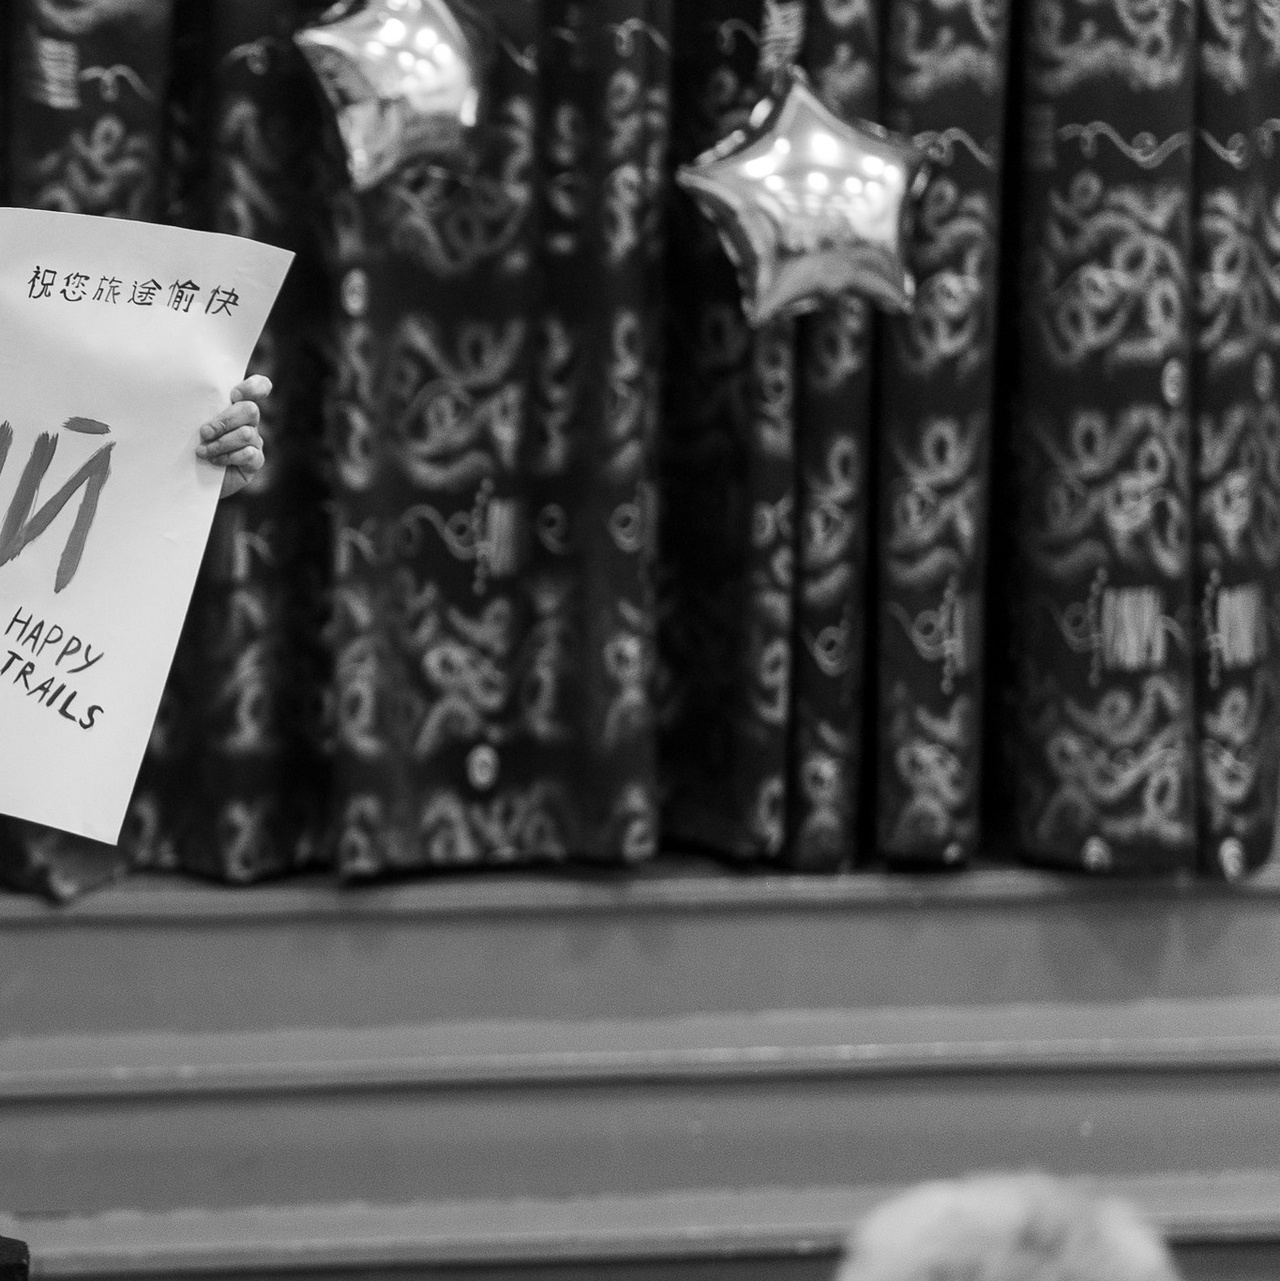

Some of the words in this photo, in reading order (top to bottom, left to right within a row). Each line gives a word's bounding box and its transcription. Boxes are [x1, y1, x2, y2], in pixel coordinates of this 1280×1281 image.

[27, 265, 239, 317] 祝您旅途愉快
[4, 606, 105, 674] HAPPY
[0, 649, 105, 730] TRAILS
